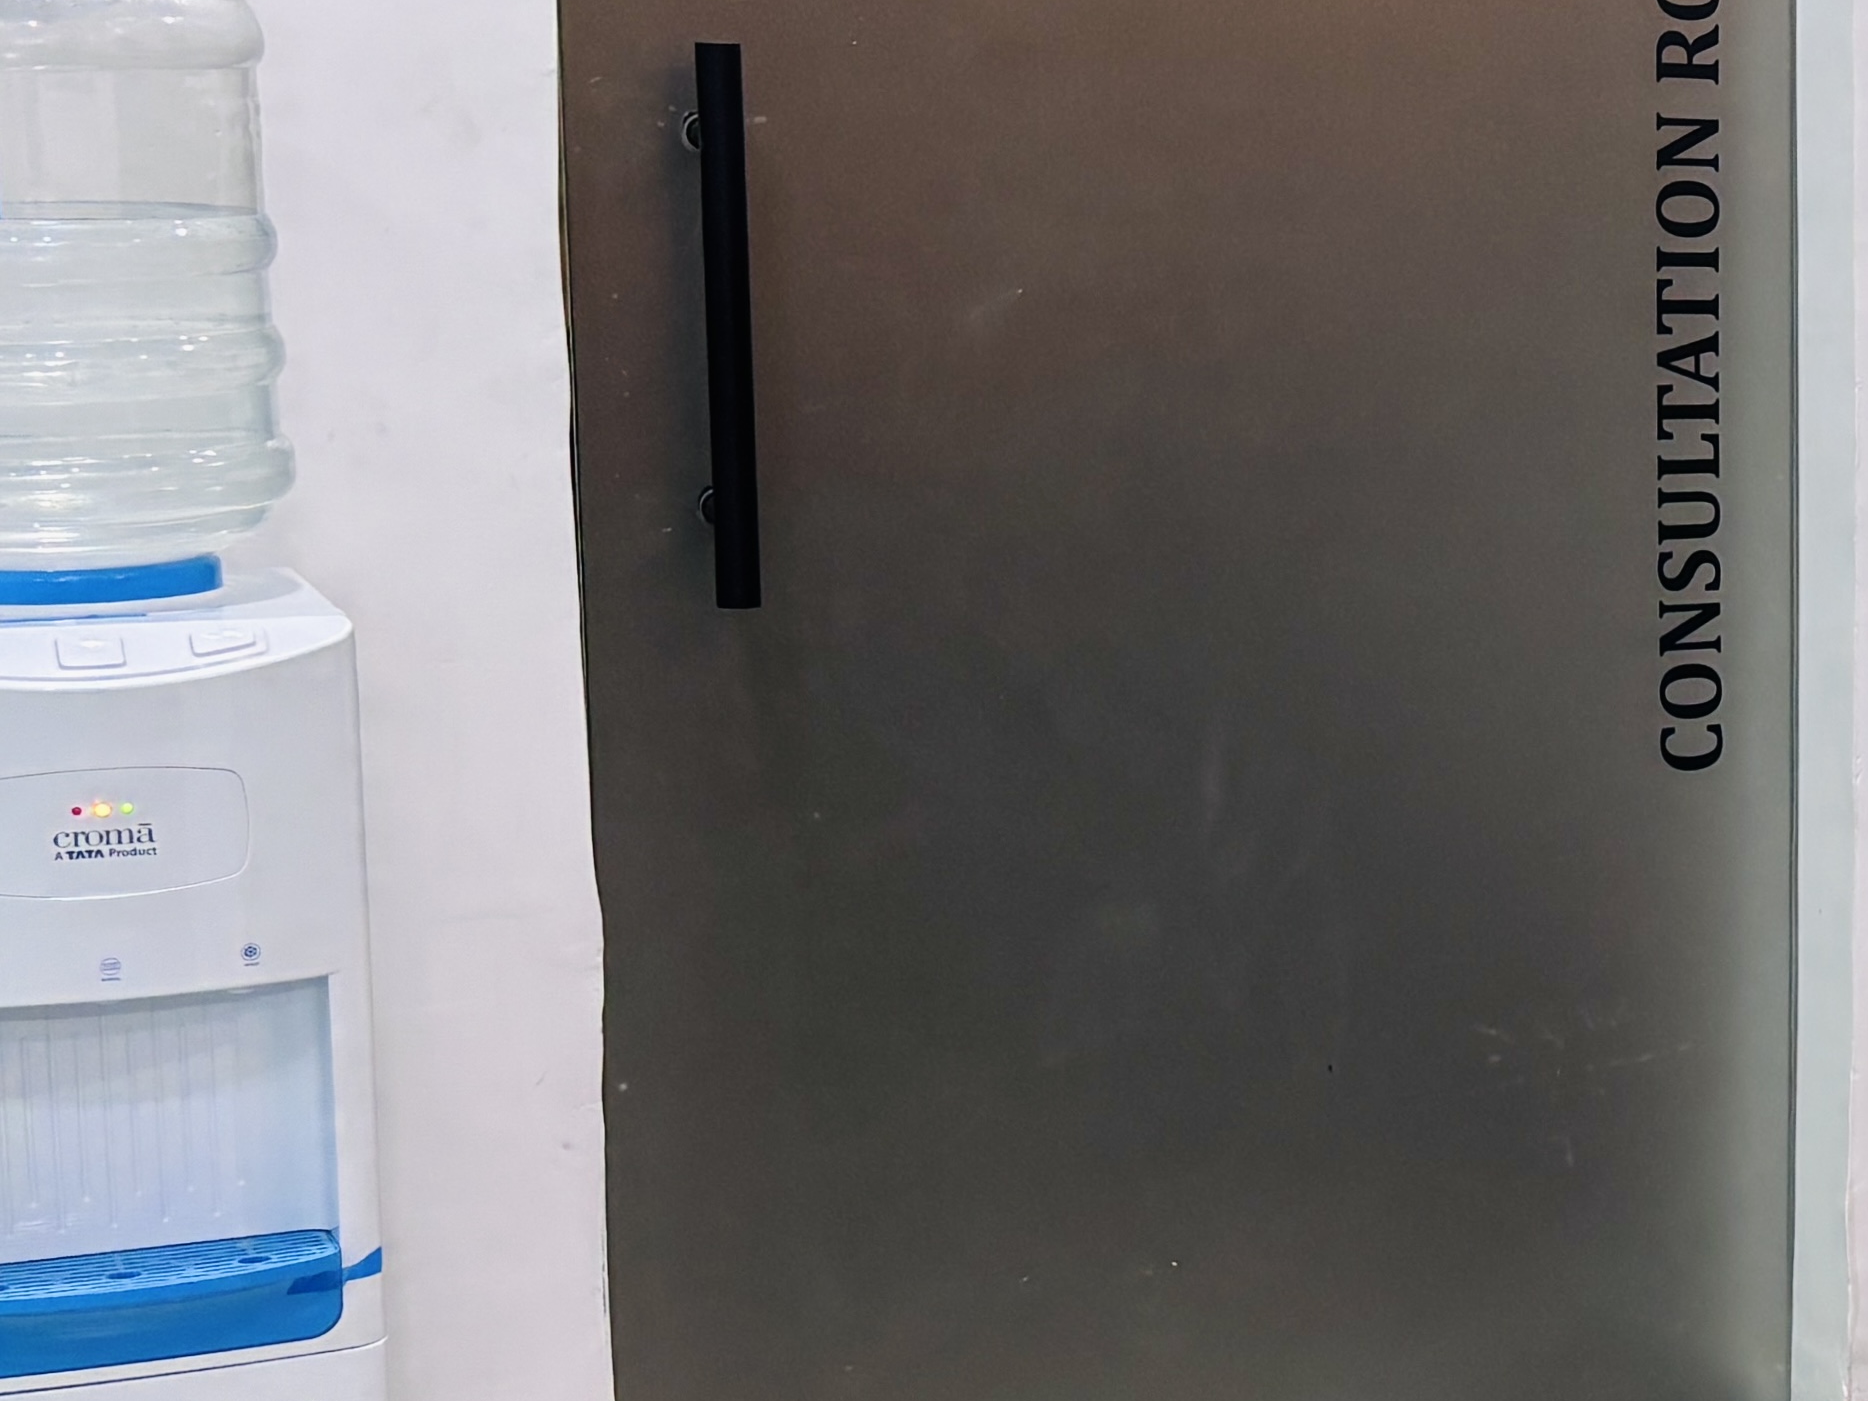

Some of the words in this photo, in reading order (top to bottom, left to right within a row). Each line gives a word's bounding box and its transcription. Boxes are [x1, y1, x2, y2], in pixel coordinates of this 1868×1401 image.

[1655, 110, 1724, 774] CONSULTATION
[54, 851, 64, 861] A
[65, 849, 105, 860] TATA
[108, 846, 158, 857] Product
